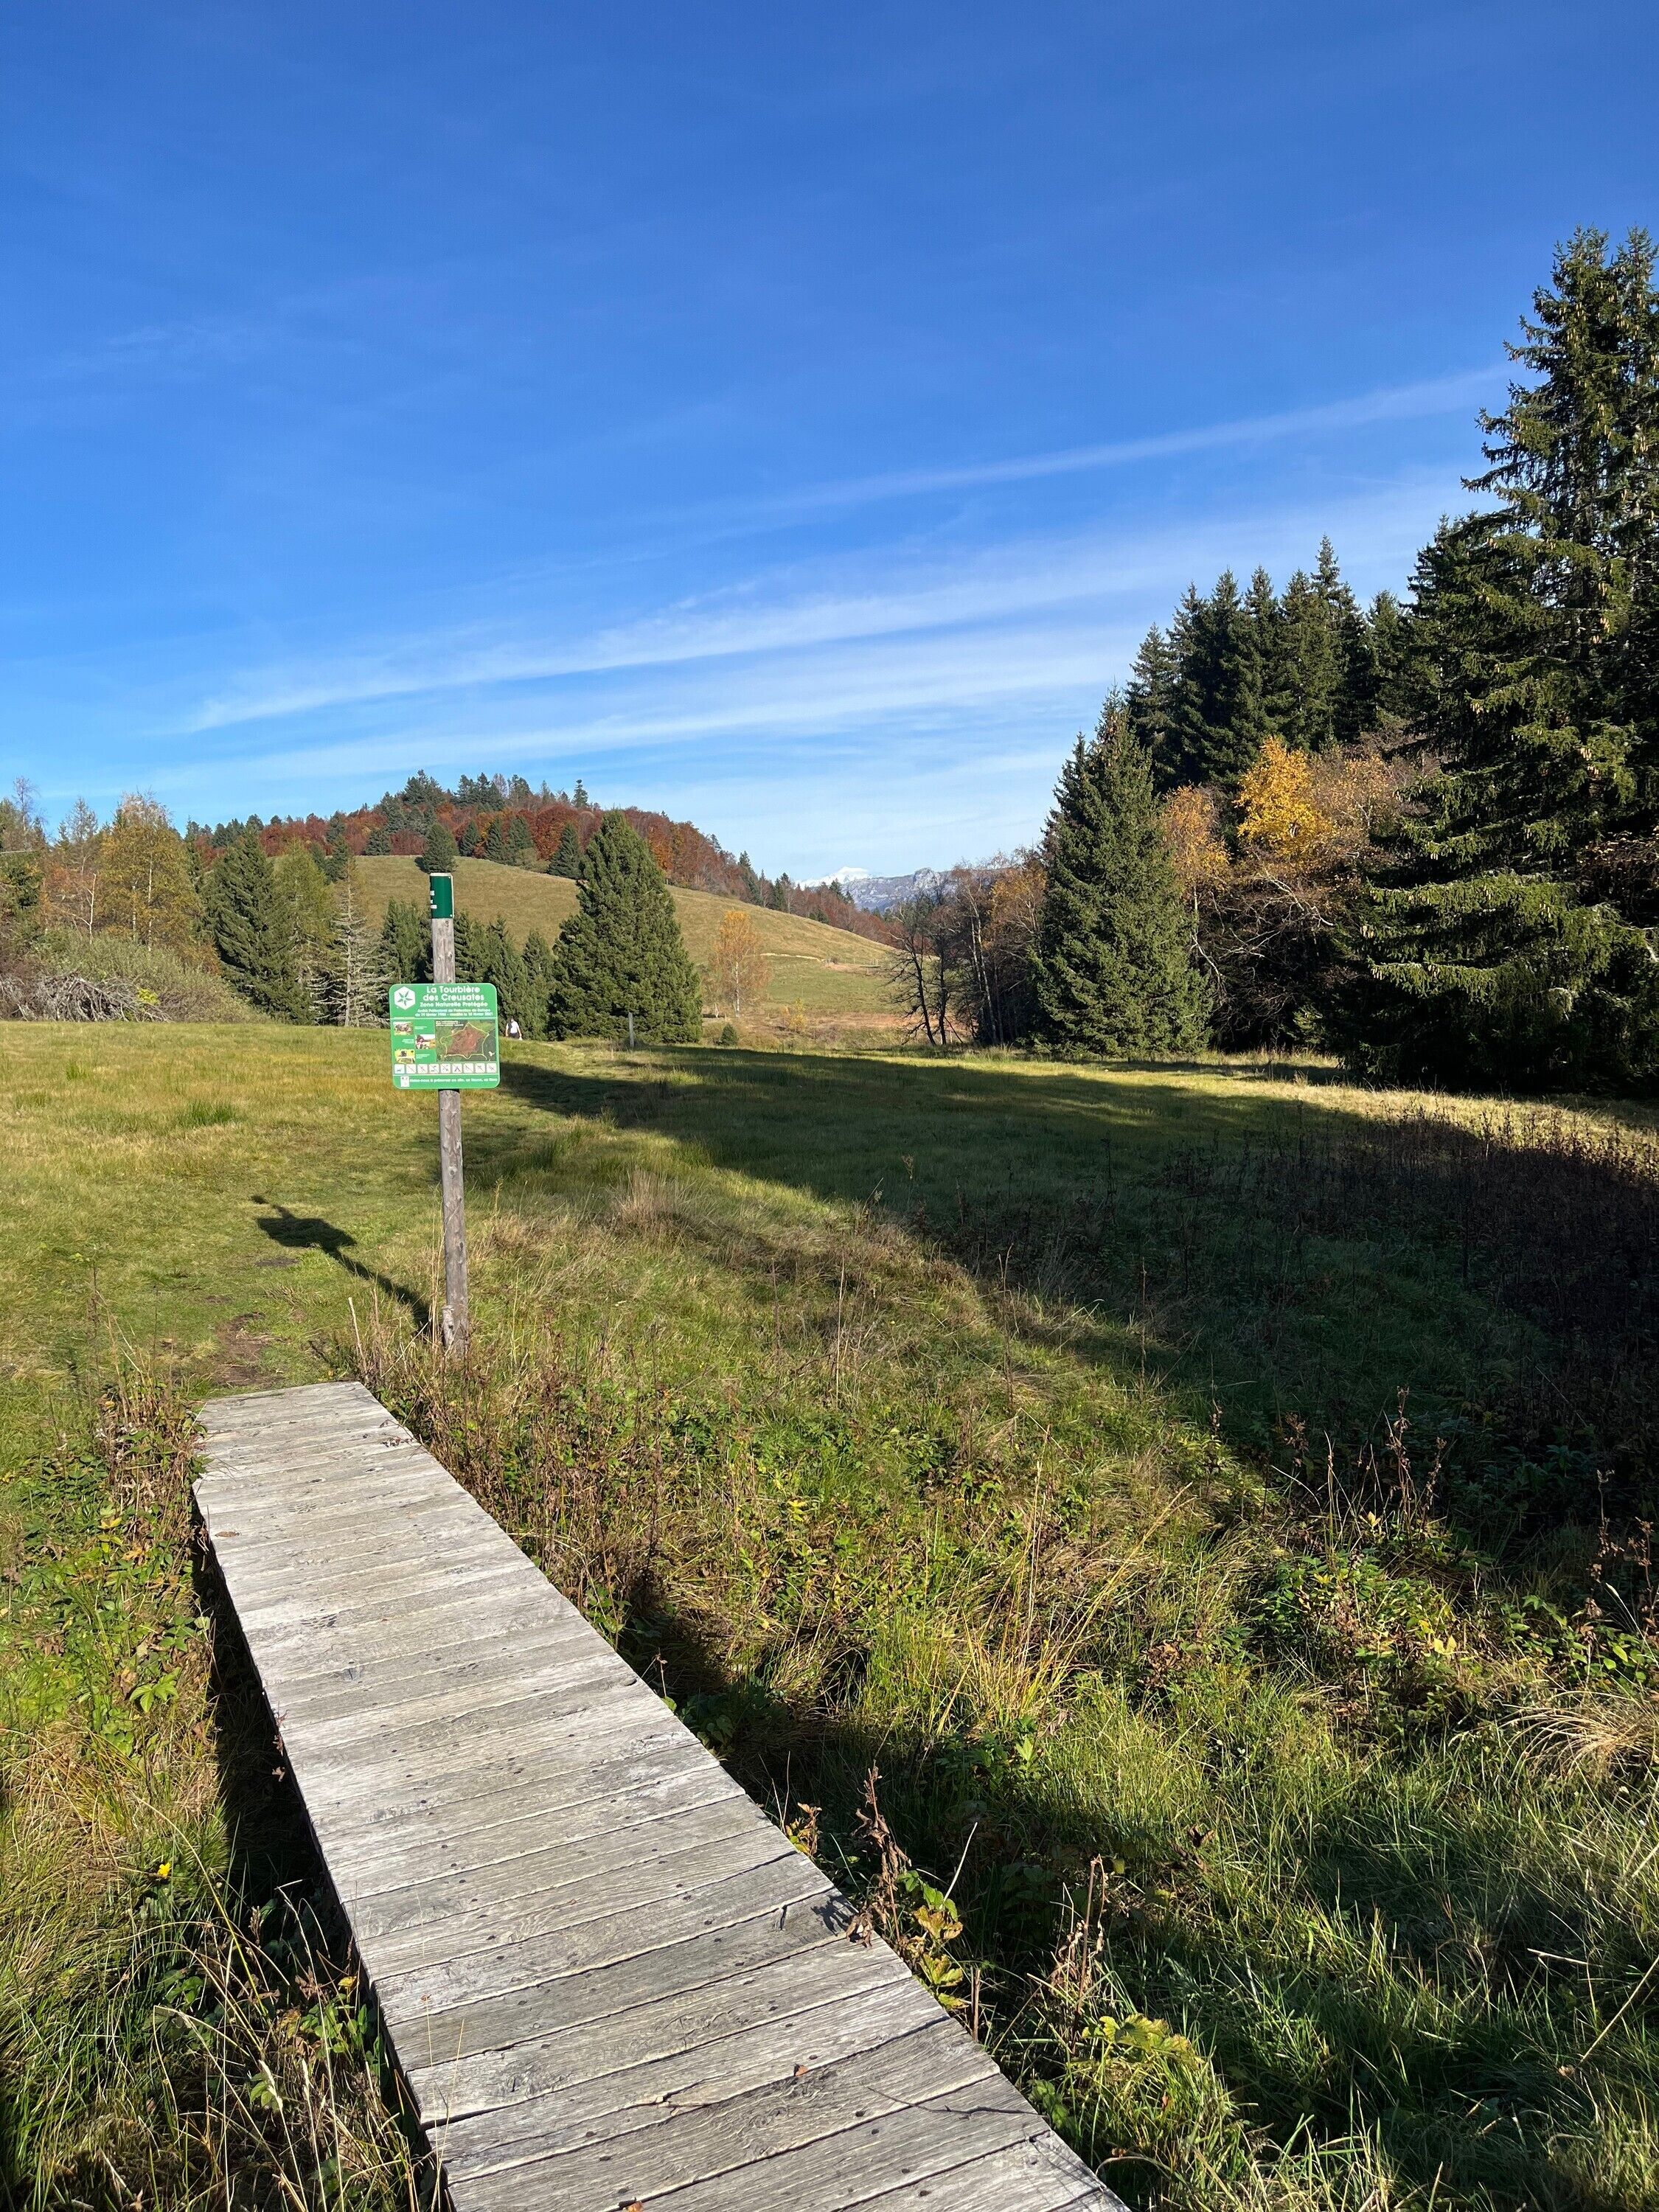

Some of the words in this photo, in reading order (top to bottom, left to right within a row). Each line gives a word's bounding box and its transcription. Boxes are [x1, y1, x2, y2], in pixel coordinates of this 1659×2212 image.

[426, 986, 437, 994] La
[439, 985, 481, 993] Tourbière
[441, 993, 484, 1001] Creusates
